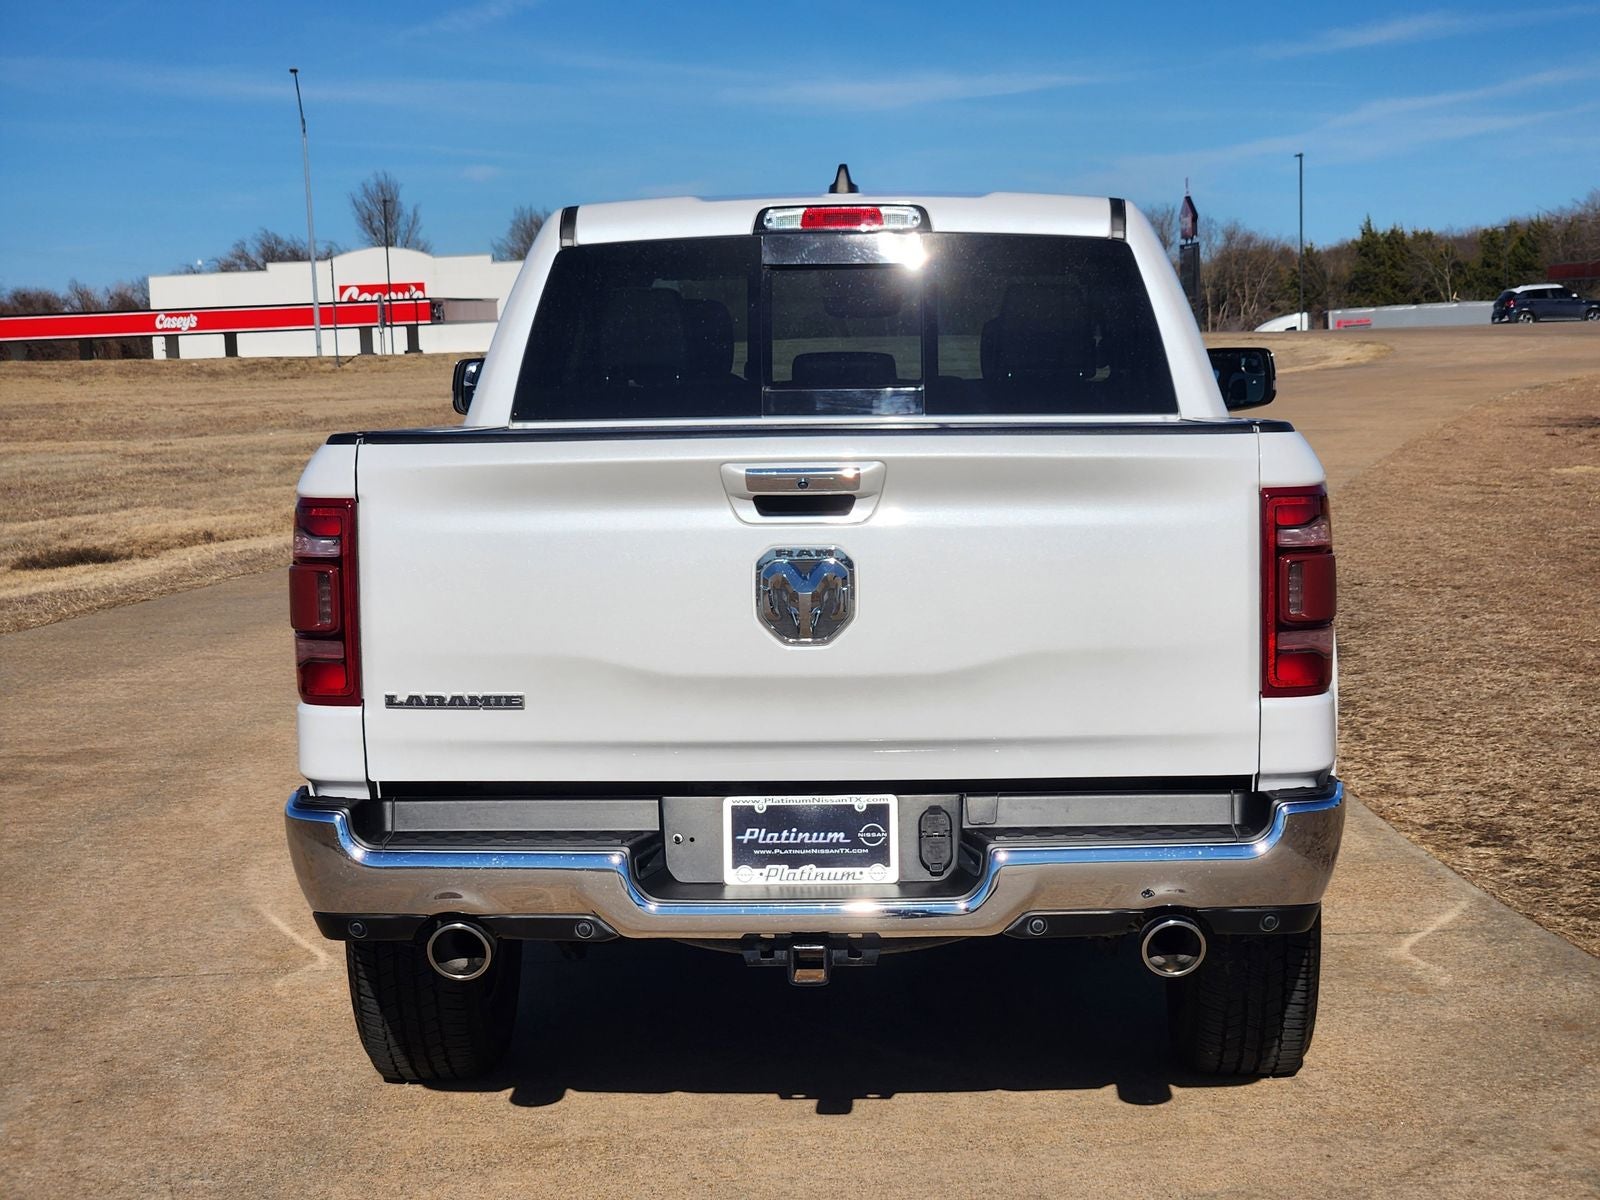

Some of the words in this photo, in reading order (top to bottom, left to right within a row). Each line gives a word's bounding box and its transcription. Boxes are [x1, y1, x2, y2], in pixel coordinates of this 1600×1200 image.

[155, 313, 198, 331] Casey's
[775, 548, 835, 558] RAM
[384, 693, 526, 710] LARAMIE
[731, 796, 889, 804] www.PlatinumNissanTX.com
[735, 827, 852, 844] Platinum
[764, 866, 863, 882] Platinum
